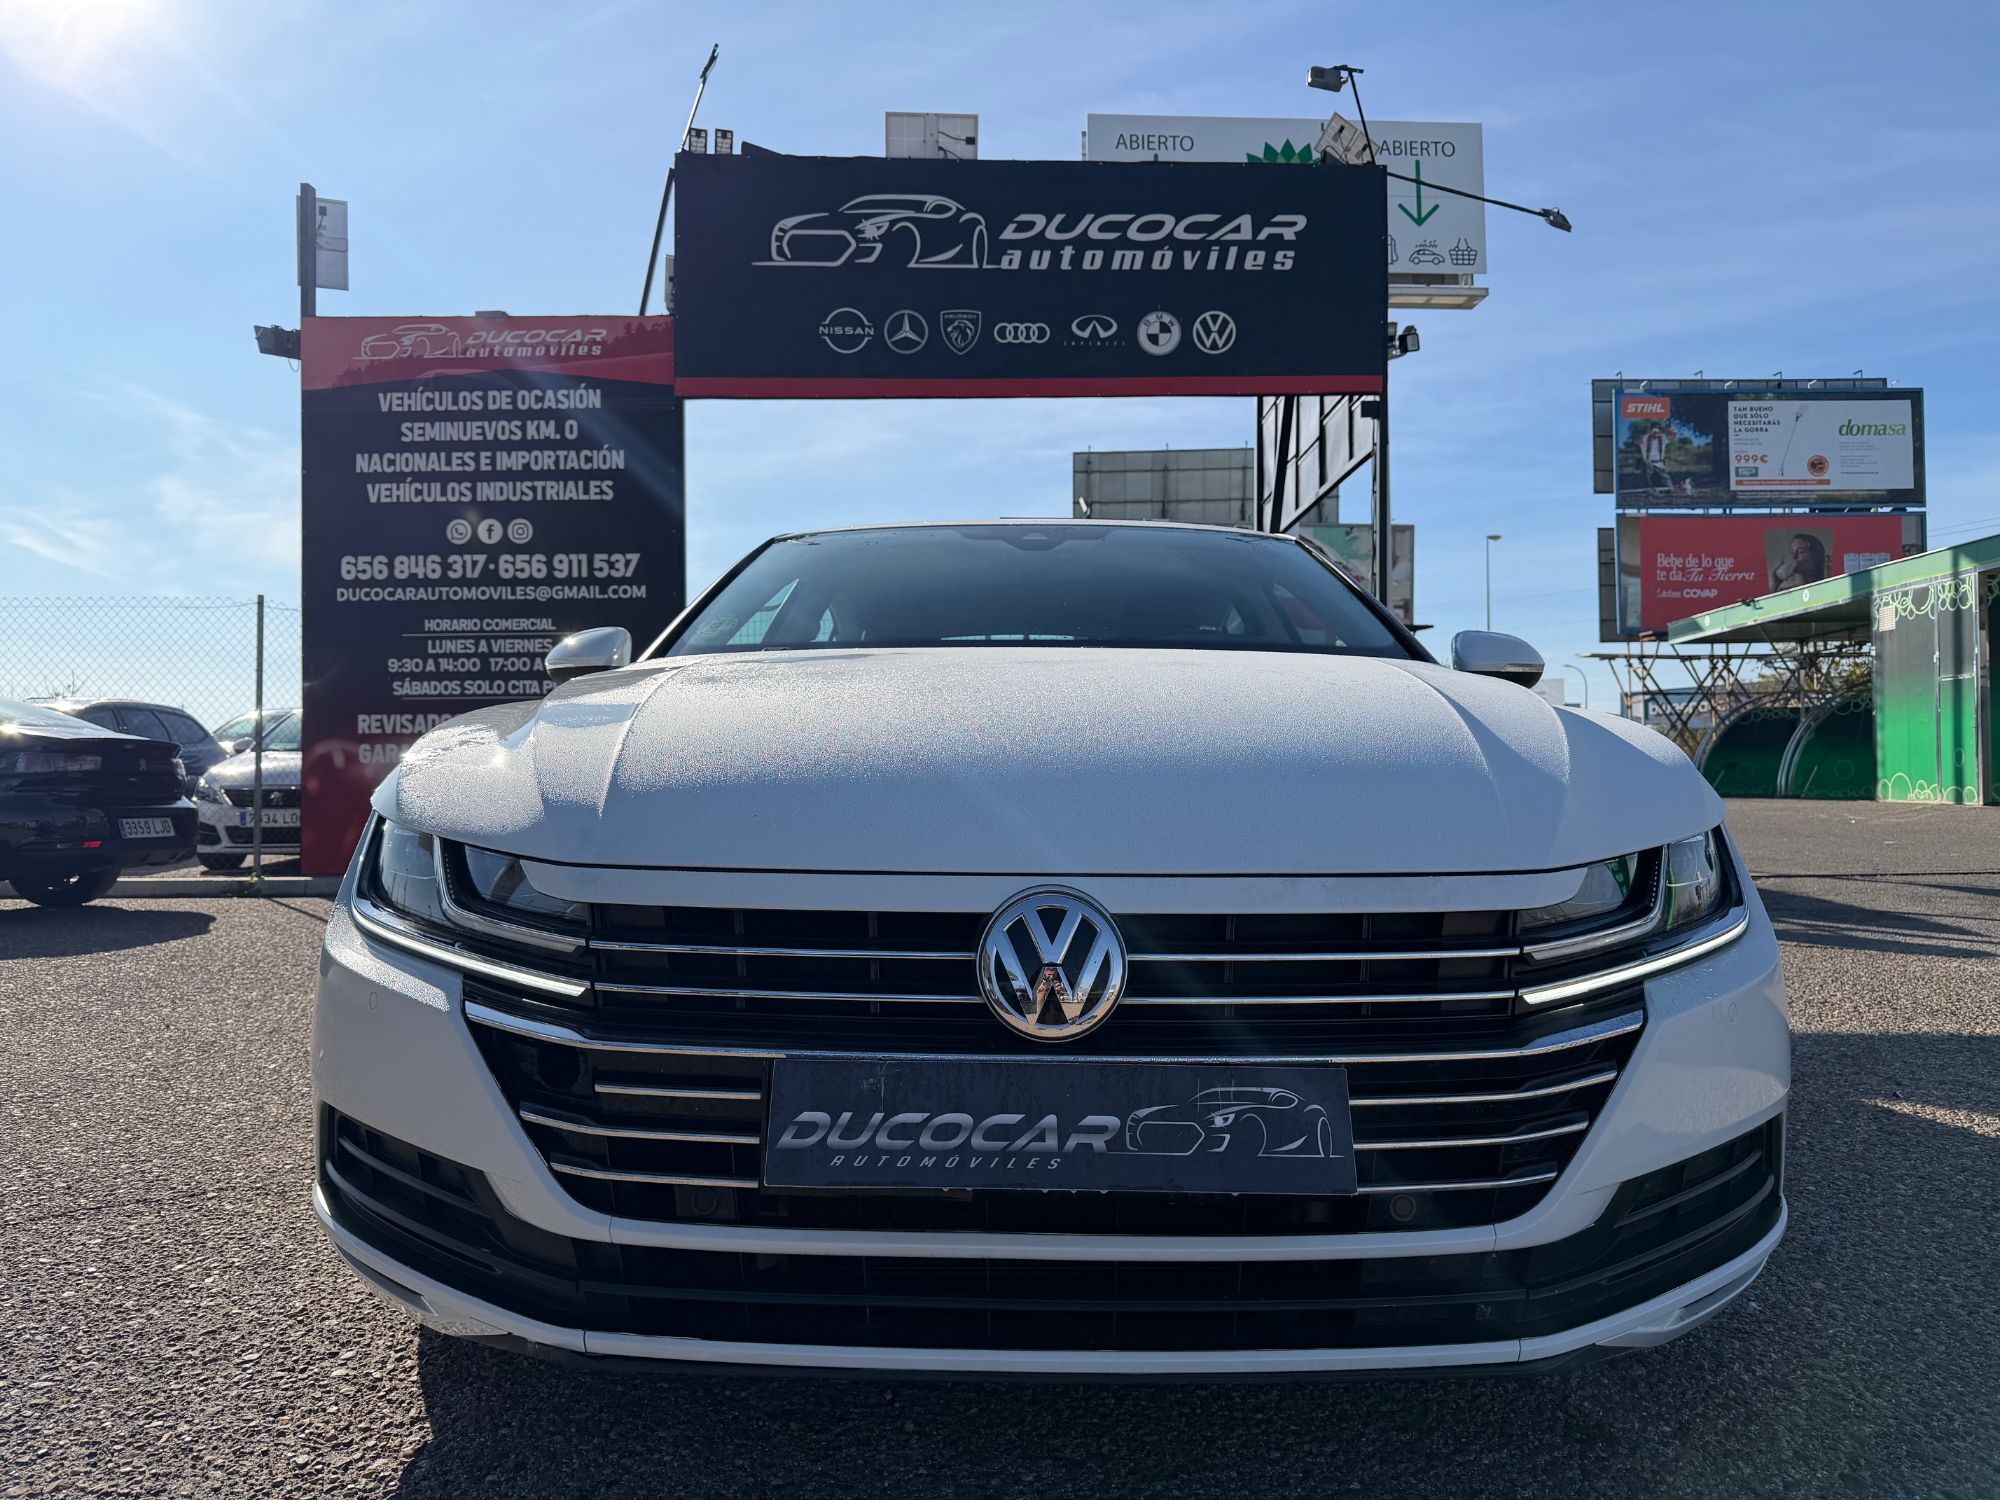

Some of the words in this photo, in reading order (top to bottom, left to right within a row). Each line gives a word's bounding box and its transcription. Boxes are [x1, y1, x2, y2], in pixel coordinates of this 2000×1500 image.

[1115, 133, 1195, 152] ABIERTO
[1379, 139, 1456, 157] ABIERTO
[999, 213, 1307, 241] DUCOCAR
[1000, 246, 1296, 270] automóviles
[465, 329, 607, 344] DUCOCAR
[818, 325, 875, 335] NISSAN
[378, 386, 484, 412] VEHÍCULOS
[487, 390, 513, 410] DE
[516, 383, 601, 409] OCASIÓN
[1626, 403, 1665, 413] STIHL
[400, 421, 522, 442] SEMINUEVOS
[526, 420, 561, 440] KM.
[1838, 418, 1907, 437] domasa
[355, 451, 476, 473] NACIONALES
[480, 451, 492, 471] E
[495, 444, 625, 470] IMPORTACIÓN
[1735, 454, 1768, 464] 999€
[366, 477, 472, 503] VEHÍCULOS
[476, 480, 614, 501] INDUSTRIALES
[340, 555, 389, 580] 656
[393, 554, 442, 579] 846
[553, 553, 588, 578] 911
[593, 553, 641, 578] 537
[1657, 553, 1683, 567] Bebe
[1685, 553, 1698, 567] de
[1701, 553, 1711, 567] lo
[1714, 556, 1734, 571] que
[1657, 569, 1667, 581] te
[1708, 566, 1755, 581] Tierra
[336, 585, 647, 601] DUCOCARAUTOMOVILES@GMAIL.COM
[1683, 588, 1718, 598] COVAP
[424, 619, 480, 631] HORARIO
[483, 618, 556, 630] COMERCIAL
[428, 640, 475, 654] LUNES
[478, 639, 489, 653] A
[491, 638, 553, 653] VIERNES
[388, 658, 424, 672] 9:30
[426, 658, 437, 672] A
[439, 658, 481, 672] 14:00
[489, 657, 531, 671] 17:00
[533, 657, 544, 671] A
[393, 677, 461, 696] SÁBADOS
[464, 680, 505, 695] SOLO
[508, 680, 541, 694] CITA
[125, 820, 151, 835] 3359
[775, 1111, 1121, 1153] DUCOCAR
[830, 1155, 1061, 1170] AUTOMÓVILES
